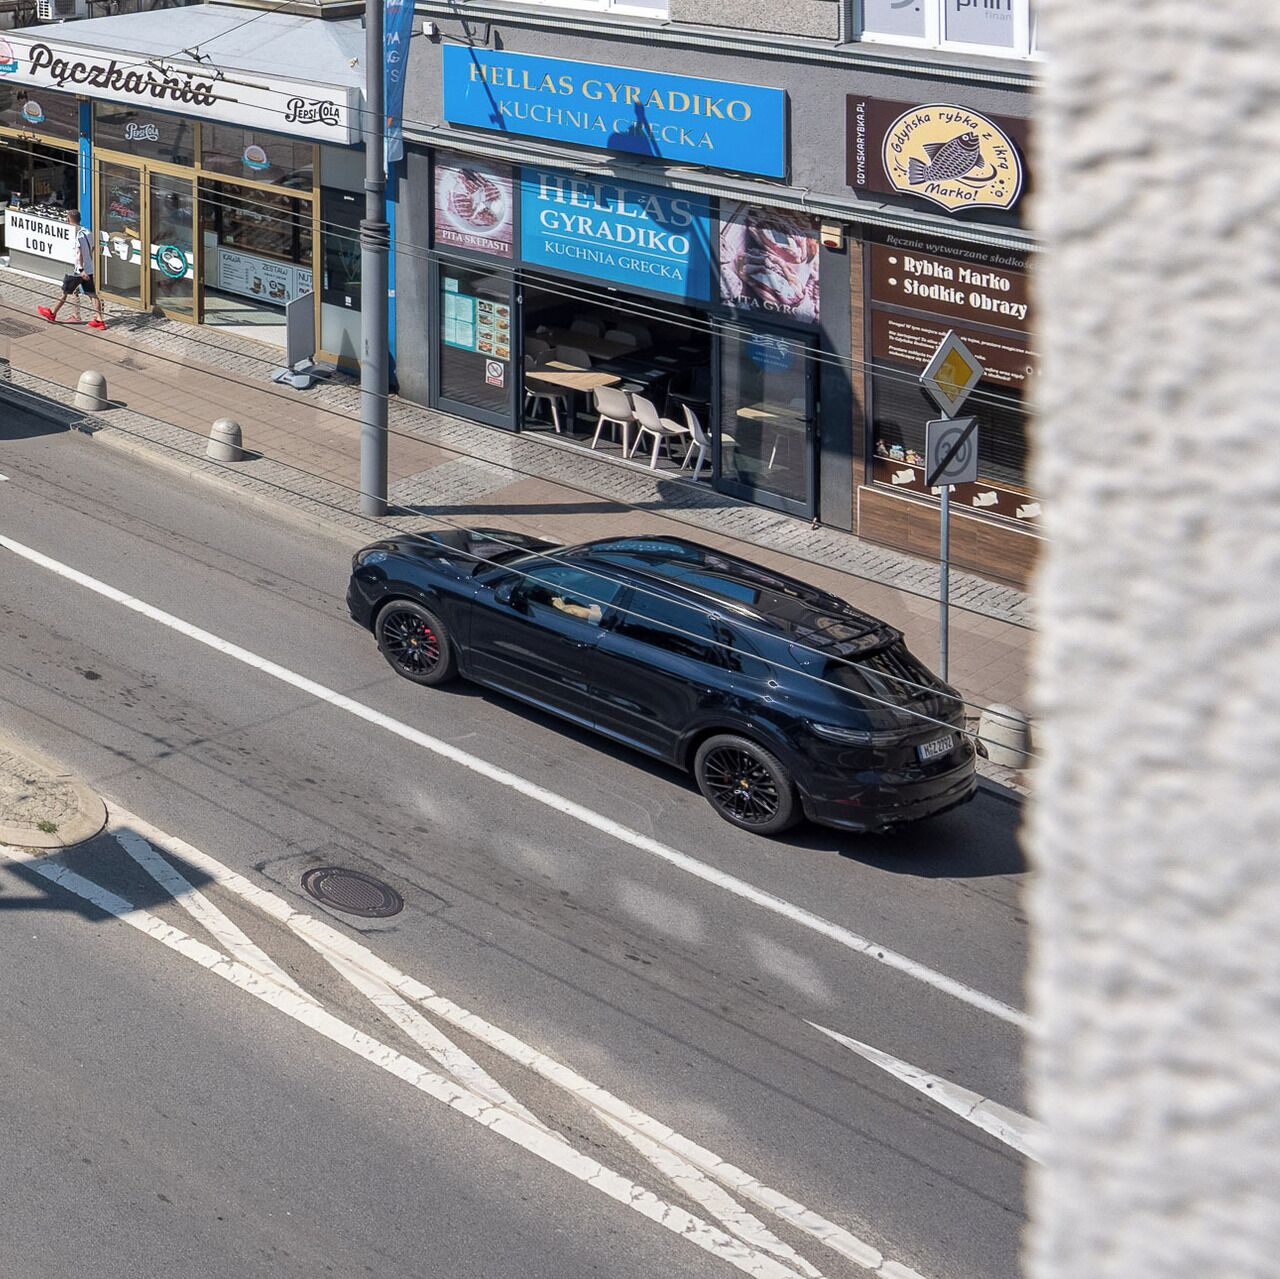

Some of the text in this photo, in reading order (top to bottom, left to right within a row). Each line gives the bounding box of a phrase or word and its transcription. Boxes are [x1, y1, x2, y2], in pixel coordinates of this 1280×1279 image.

[28, 43, 220, 108] Pączkarnia
[468, 62, 753, 122] HELLAS GYRADIKO
[498, 100, 715, 150] KUCHNIA GRECKA
[891, 111, 1009, 170] Gdyńska rybka z ikrą
[537, 173, 693, 227] HELLAS
[924, 182, 978, 202] Marko!
[11, 215, 70, 241] NATURALNE
[25, 237, 53, 255] LODY
[442, 230, 509, 252] PITA SKEPASTI
[540, 209, 690, 255] GYRADIKO
[886, 234, 924, 249] Ręcznie
[925, 243, 989, 262] wytwarzane
[545, 241, 683, 281] KUCHNIA GRECKA
[903, 256, 1010, 291] Rybka Marko
[763, 300, 798, 315] GYRO
[903, 278, 1028, 320] Słodkie Obrazy
